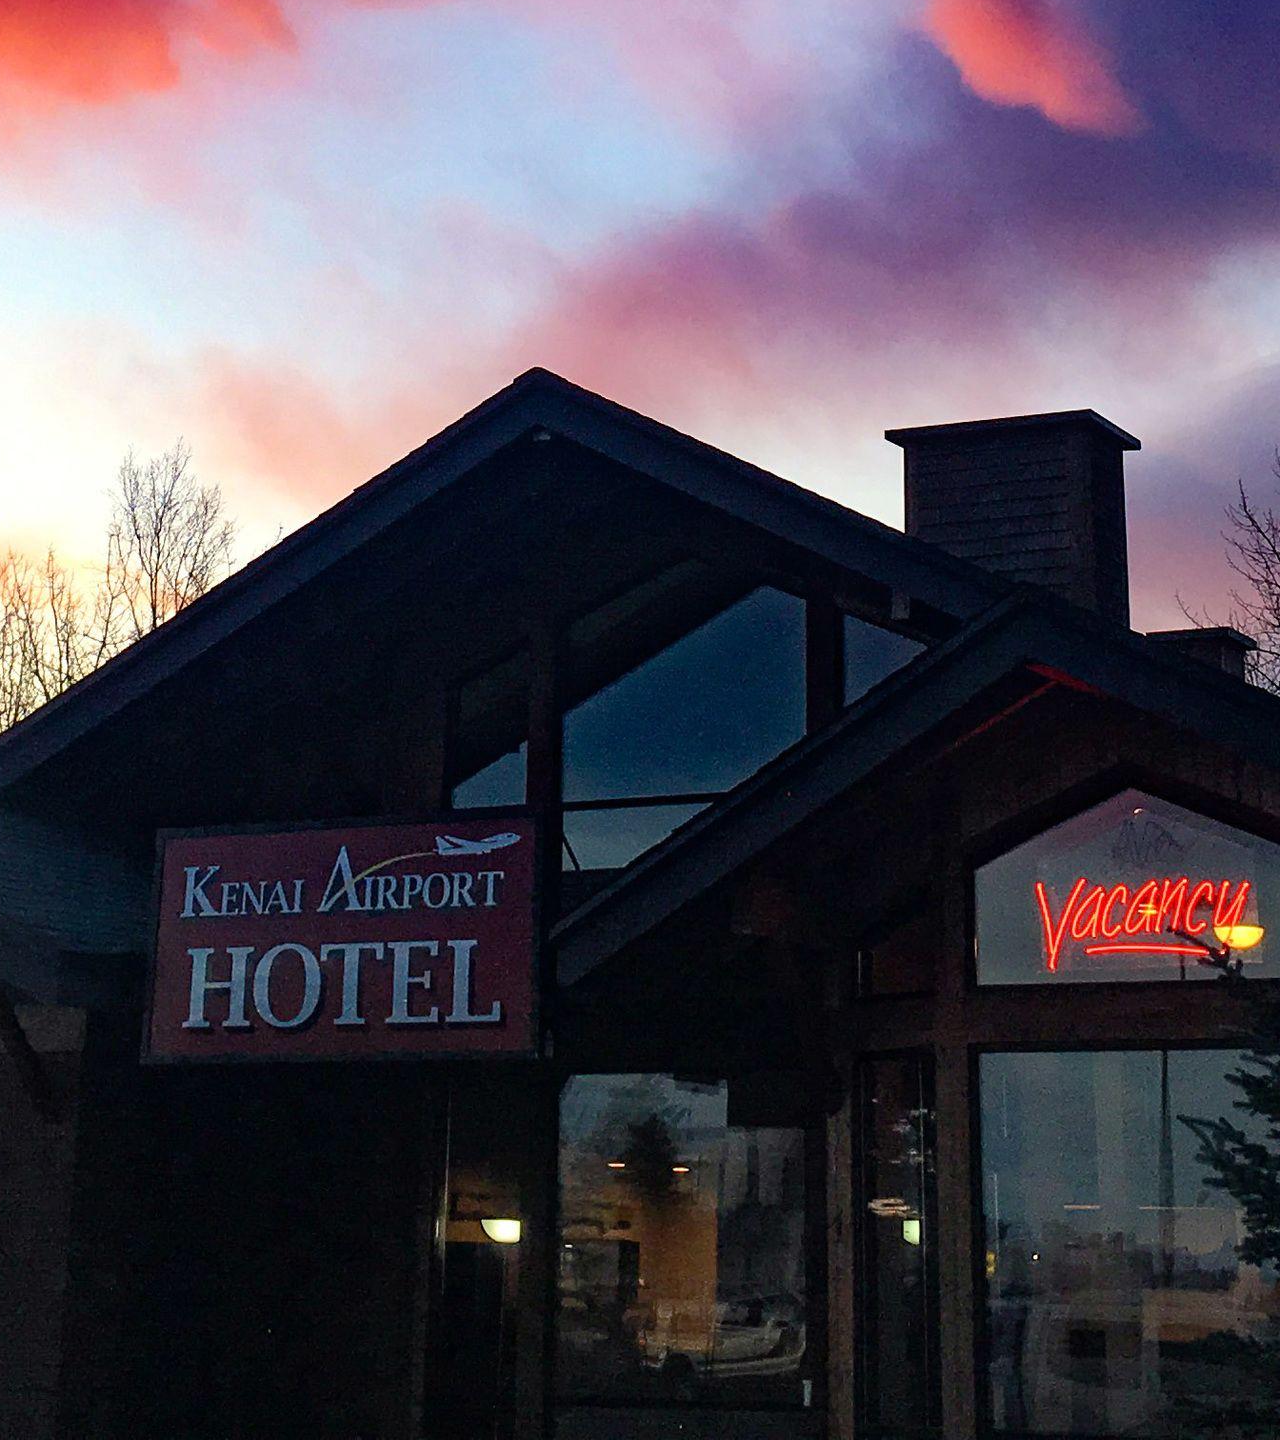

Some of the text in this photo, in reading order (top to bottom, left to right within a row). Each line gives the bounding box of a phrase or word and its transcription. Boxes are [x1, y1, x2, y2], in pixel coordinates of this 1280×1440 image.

[180, 844, 505, 918] KENAI AIRPORT
[1035, 877, 1251, 972] Vacancy
[181, 938, 502, 1029] HOTEL
